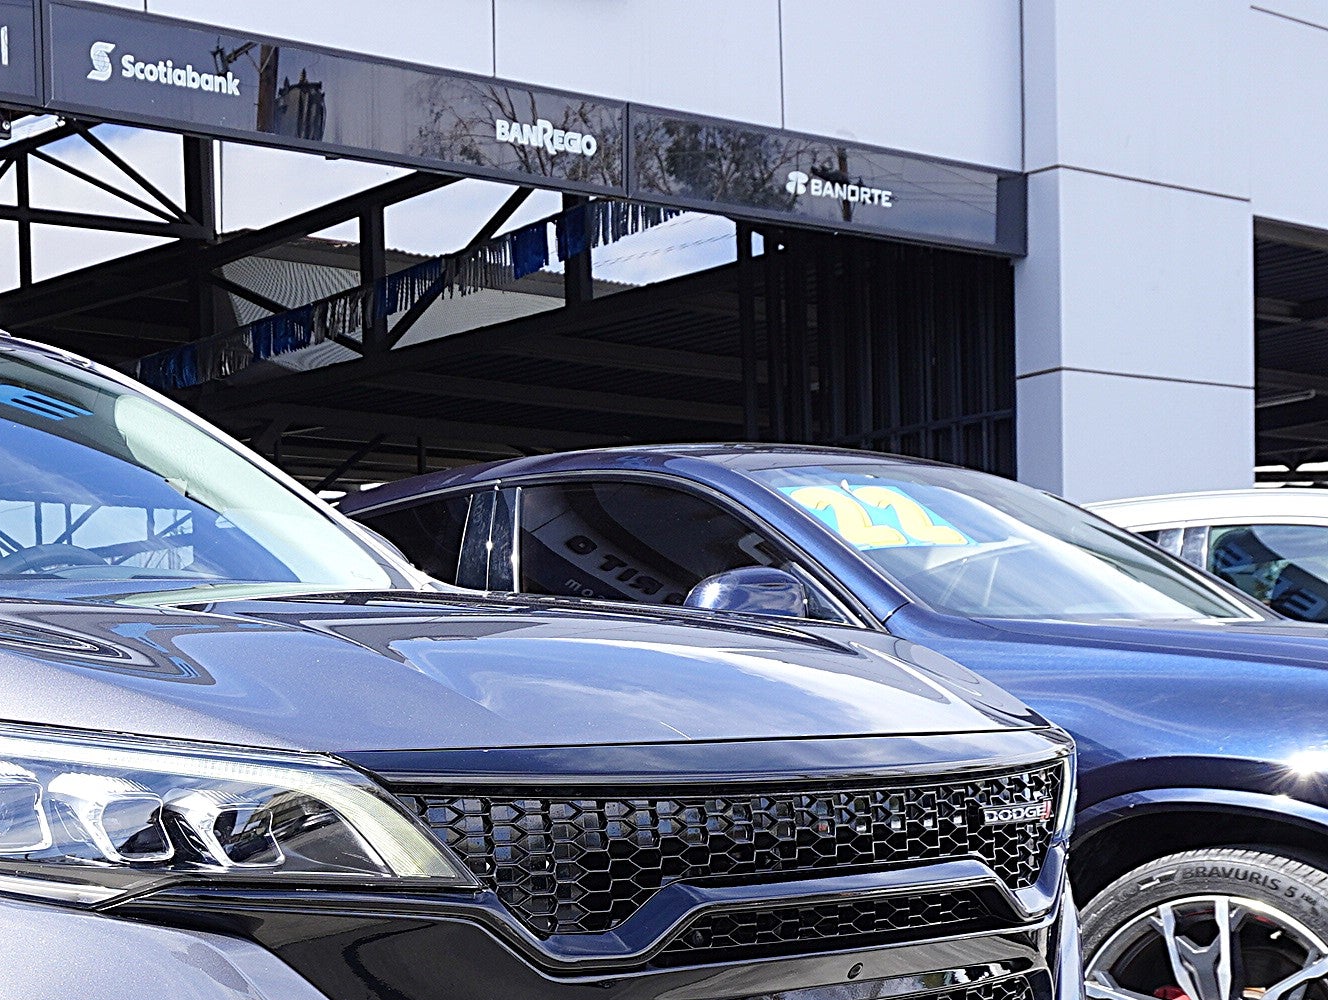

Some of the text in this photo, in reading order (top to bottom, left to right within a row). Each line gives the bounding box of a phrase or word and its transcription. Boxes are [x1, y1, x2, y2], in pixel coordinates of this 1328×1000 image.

[121, 54, 241, 96] Scotiabank
[811, 179, 892, 208] BANORTE
[984, 805, 1045, 822] DODGE
[1181, 865, 1282, 891] BRAVURIS
[1284, 885, 1299, 898] 5
